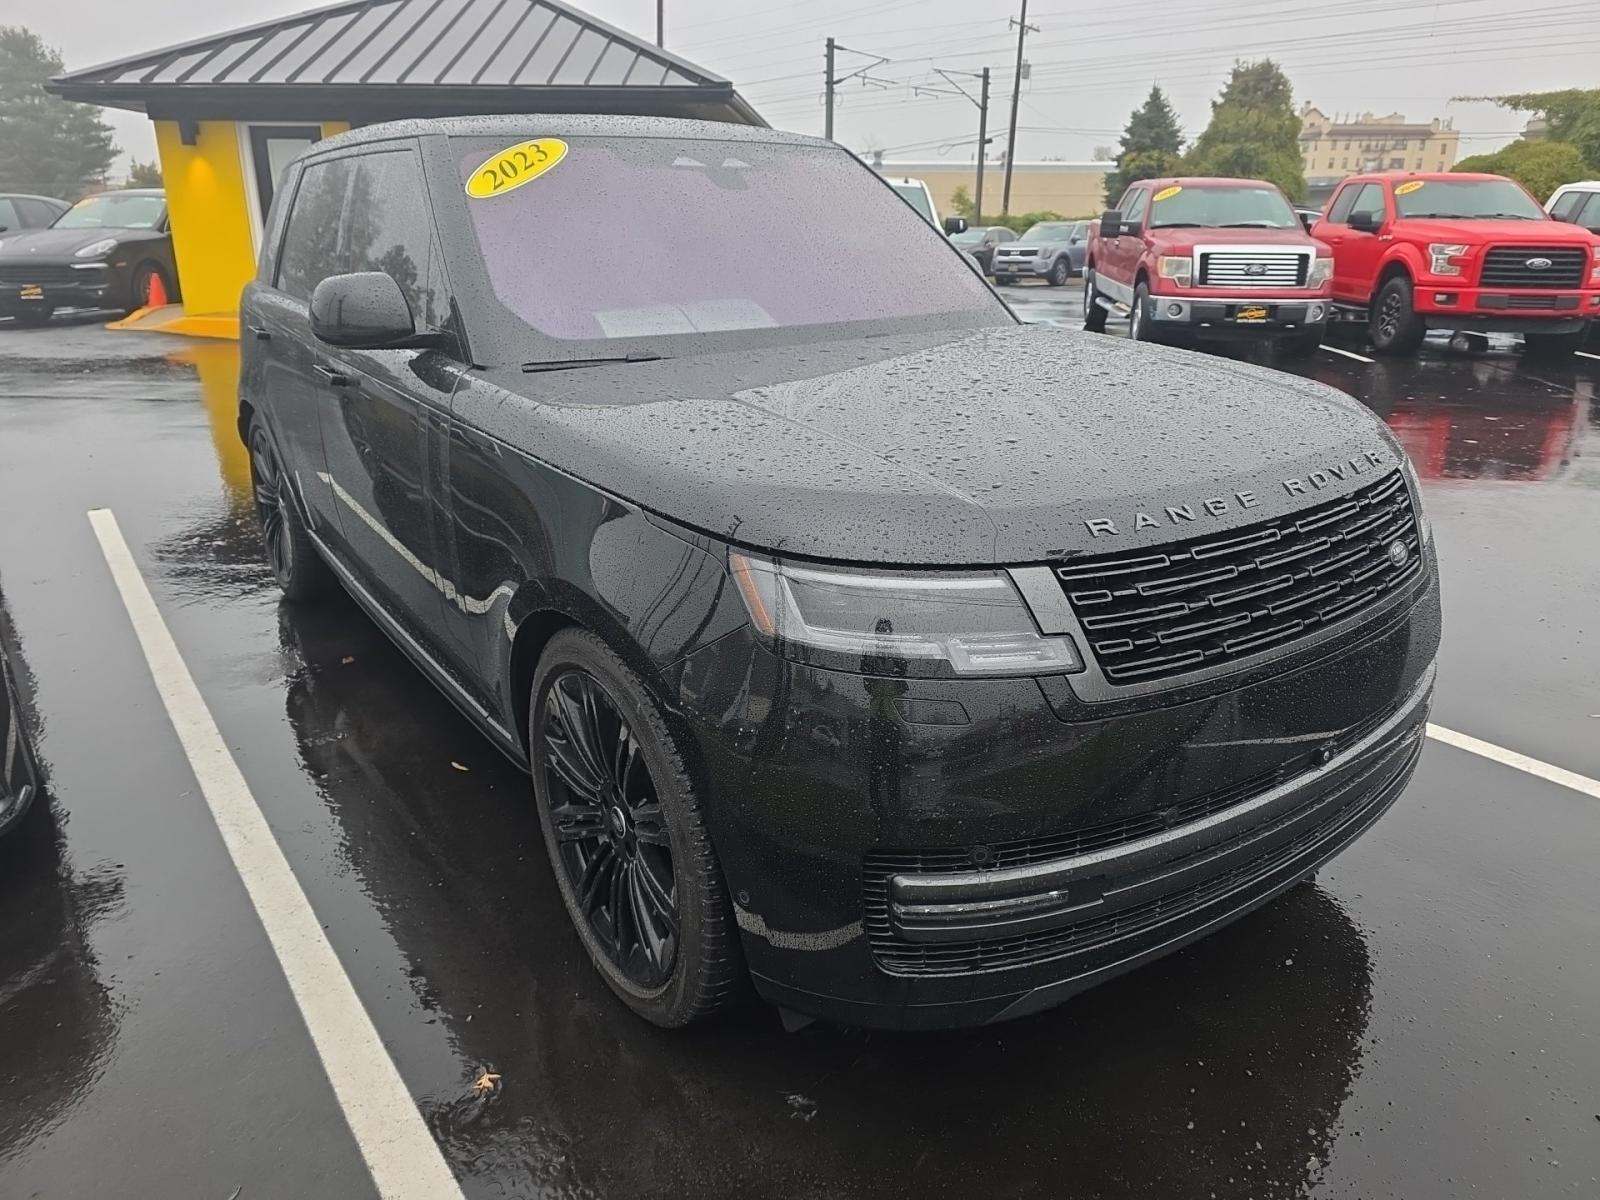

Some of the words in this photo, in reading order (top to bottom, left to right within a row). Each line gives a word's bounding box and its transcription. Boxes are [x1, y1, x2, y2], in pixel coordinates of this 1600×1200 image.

[482, 144, 548, 190] 2023
[1084, 490, 1261, 538] RANGE
[1282, 451, 1382, 497] ROVER
